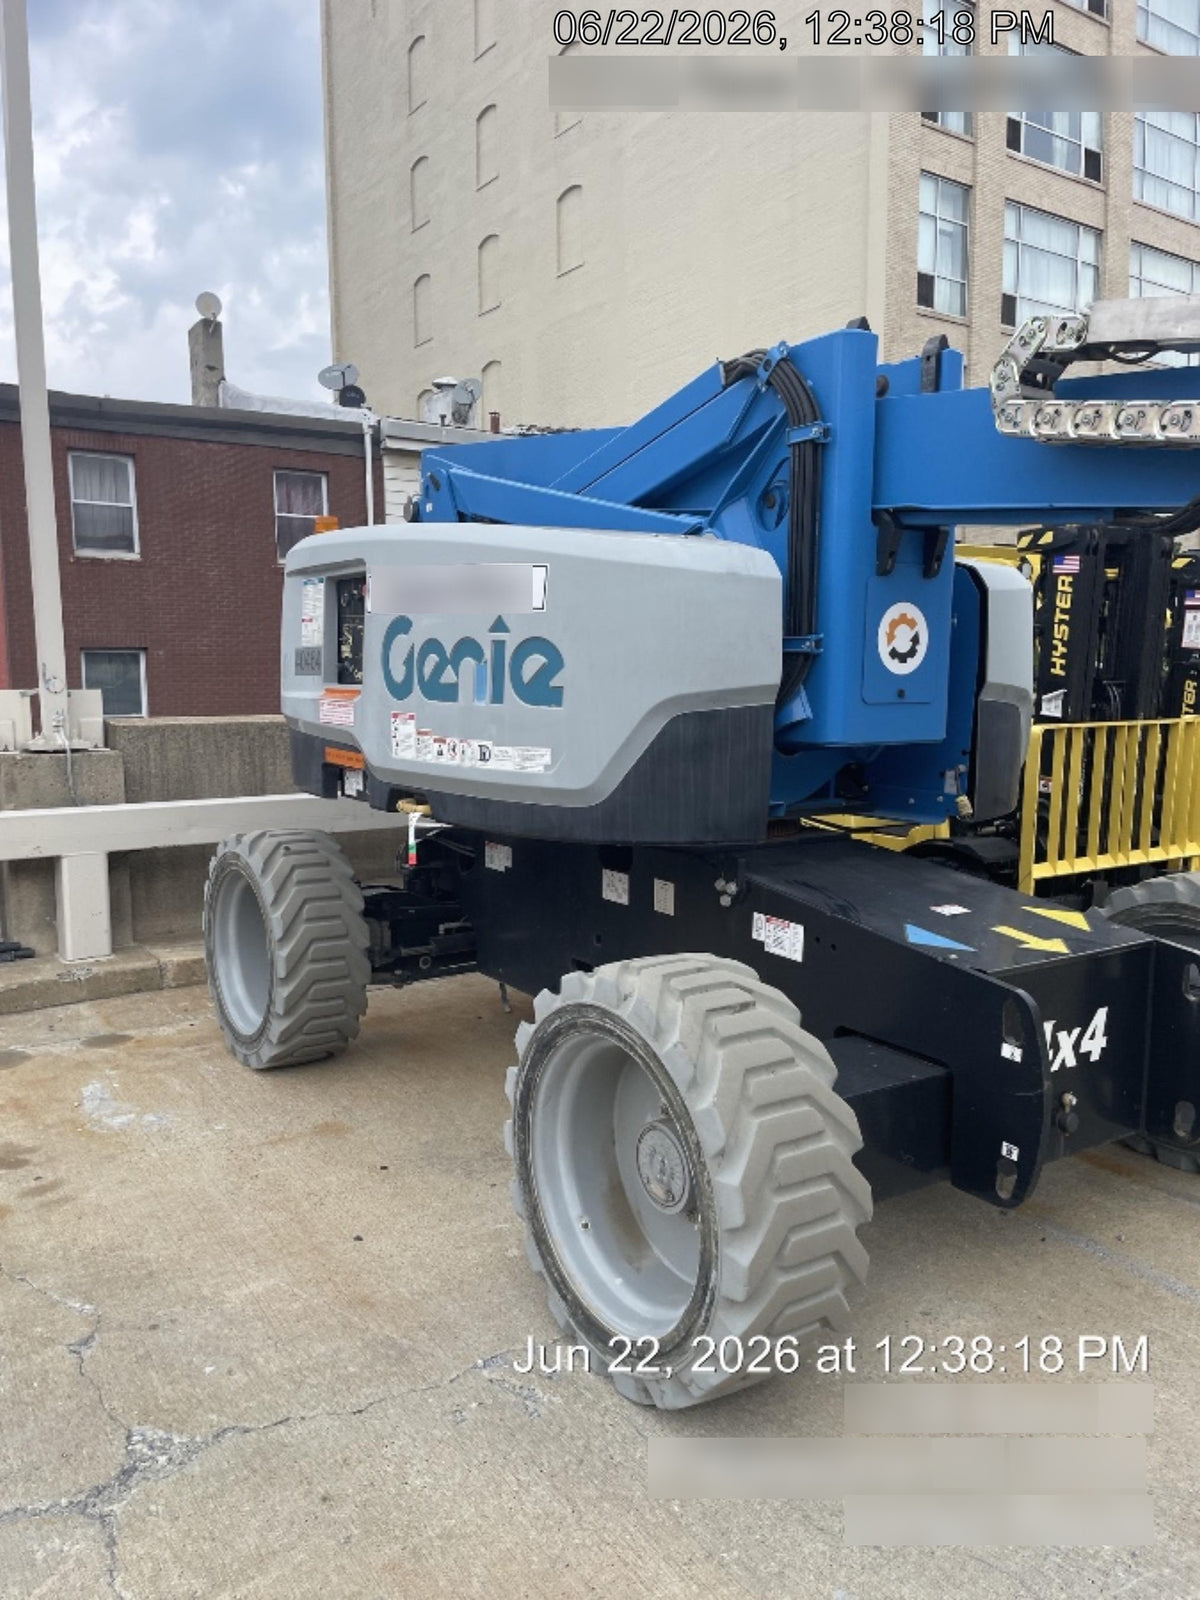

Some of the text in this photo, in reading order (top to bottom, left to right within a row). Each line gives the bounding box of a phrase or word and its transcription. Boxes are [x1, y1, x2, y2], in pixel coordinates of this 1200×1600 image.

[382, 615, 565, 708] Genie
[1050, 575, 1074, 677] HYSTER
[1181, 679, 1198, 715] TER
